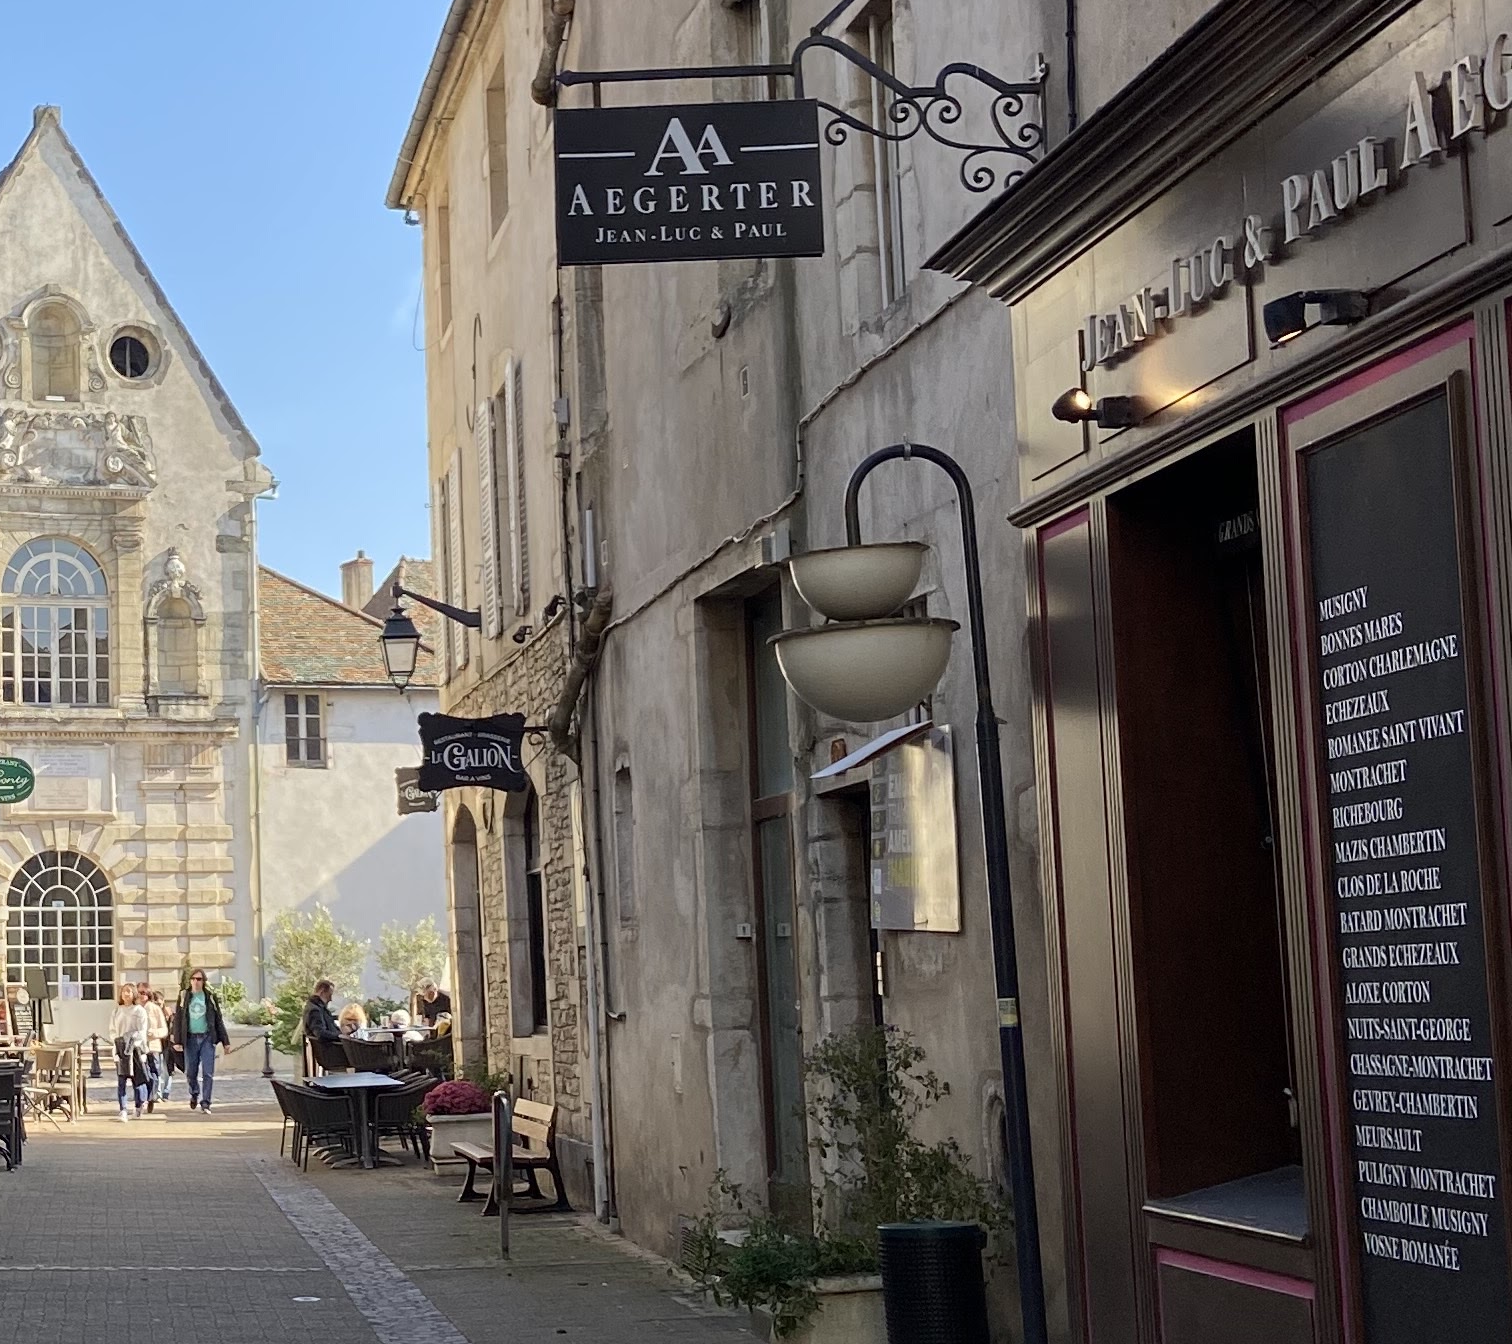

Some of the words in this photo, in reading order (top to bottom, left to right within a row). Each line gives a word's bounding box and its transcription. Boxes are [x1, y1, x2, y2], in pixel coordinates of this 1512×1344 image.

[568, 180, 814, 215] AEGERTER
[711, 226, 724, 239] &
[735, 222, 787, 238] PAUL
[1081, 235, 1234, 372] JEAN-LUC
[1281, 136, 1388, 244] PAUL
[1319, 586, 1368, 621] MUSIGNY
[1321, 624, 1362, 655] BONNES
[1364, 612, 1403, 642] MARES
[1323, 658, 1367, 690] CORTON
[1369, 635, 1458, 677] CHARLEMAGNE
[1326, 690, 1390, 725] ECHEZEAUX
[1328, 724, 1381, 759] ROMANEE
[1382, 720, 1416, 748] SAINT
[1418, 710, 1464, 741] VIVANT
[443, 742, 522, 773] GALION
[1330, 759, 1407, 794] MONTRACHET
[1333, 798, 1403, 828] RICHEBOURG
[1335, 839, 1368, 863] MAZIS
[1370, 828, 1446, 860] CHAMBERTIN
[1338, 874, 1364, 898] CLOS
[1366, 873, 1382, 896] DE
[1384, 871, 1399, 895] LA
[1400, 867, 1441, 892] ROCHE
[1340, 909, 1382, 934] BATARD
[1384, 903, 1467, 931] MONTRACHET
[1342, 946, 1387, 969] GRANDS
[1389, 942, 1459, 966] ECHEZEAUX
[1345, 982, 1381, 1004] ALOXE
[1383, 981, 1431, 1003] CORTON
[1347, 1017, 1471, 1041] NUITS-SAINT-GEORGE
[1350, 1054, 1493, 1080] CHASSAGNE-MONTRACHET
[1353, 1090, 1478, 1119] GEVREY-CHAMBERTIN
[1355, 1125, 1422, 1152] MEURSAULT
[1358, 1160, 1409, 1189] PULIGNY
[1410, 1166, 1495, 1199] MONTRACHET
[1361, 1197, 1430, 1228] CHAMBOLLE
[1431, 1206, 1489, 1237] MUSIGNY
[1363, 1232, 1400, 1260] VOSNE
[1401, 1240, 1460, 1271] ROMANÉE
